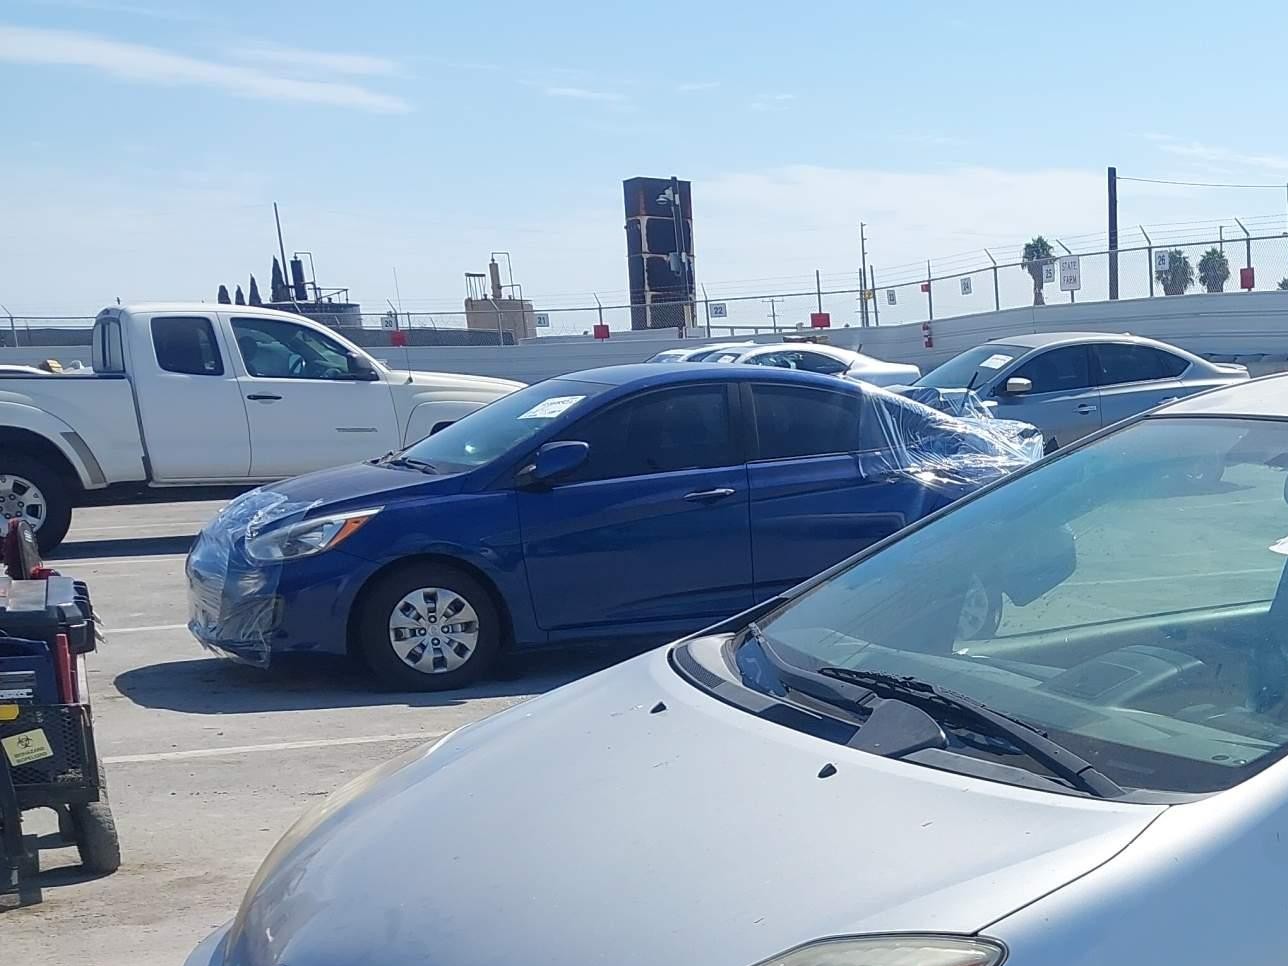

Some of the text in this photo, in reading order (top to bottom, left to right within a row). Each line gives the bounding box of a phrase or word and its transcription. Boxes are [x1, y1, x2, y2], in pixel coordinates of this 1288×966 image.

[1157, 254, 1166, 266] 26
[1062, 261, 1078, 271] STATE
[1045, 269, 1053, 279] 25
[1063, 274, 1077, 283] FARM
[713, 306, 724, 315] 22
[384, 320, 393, 328] 20
[537, 316, 547, 325] 21
